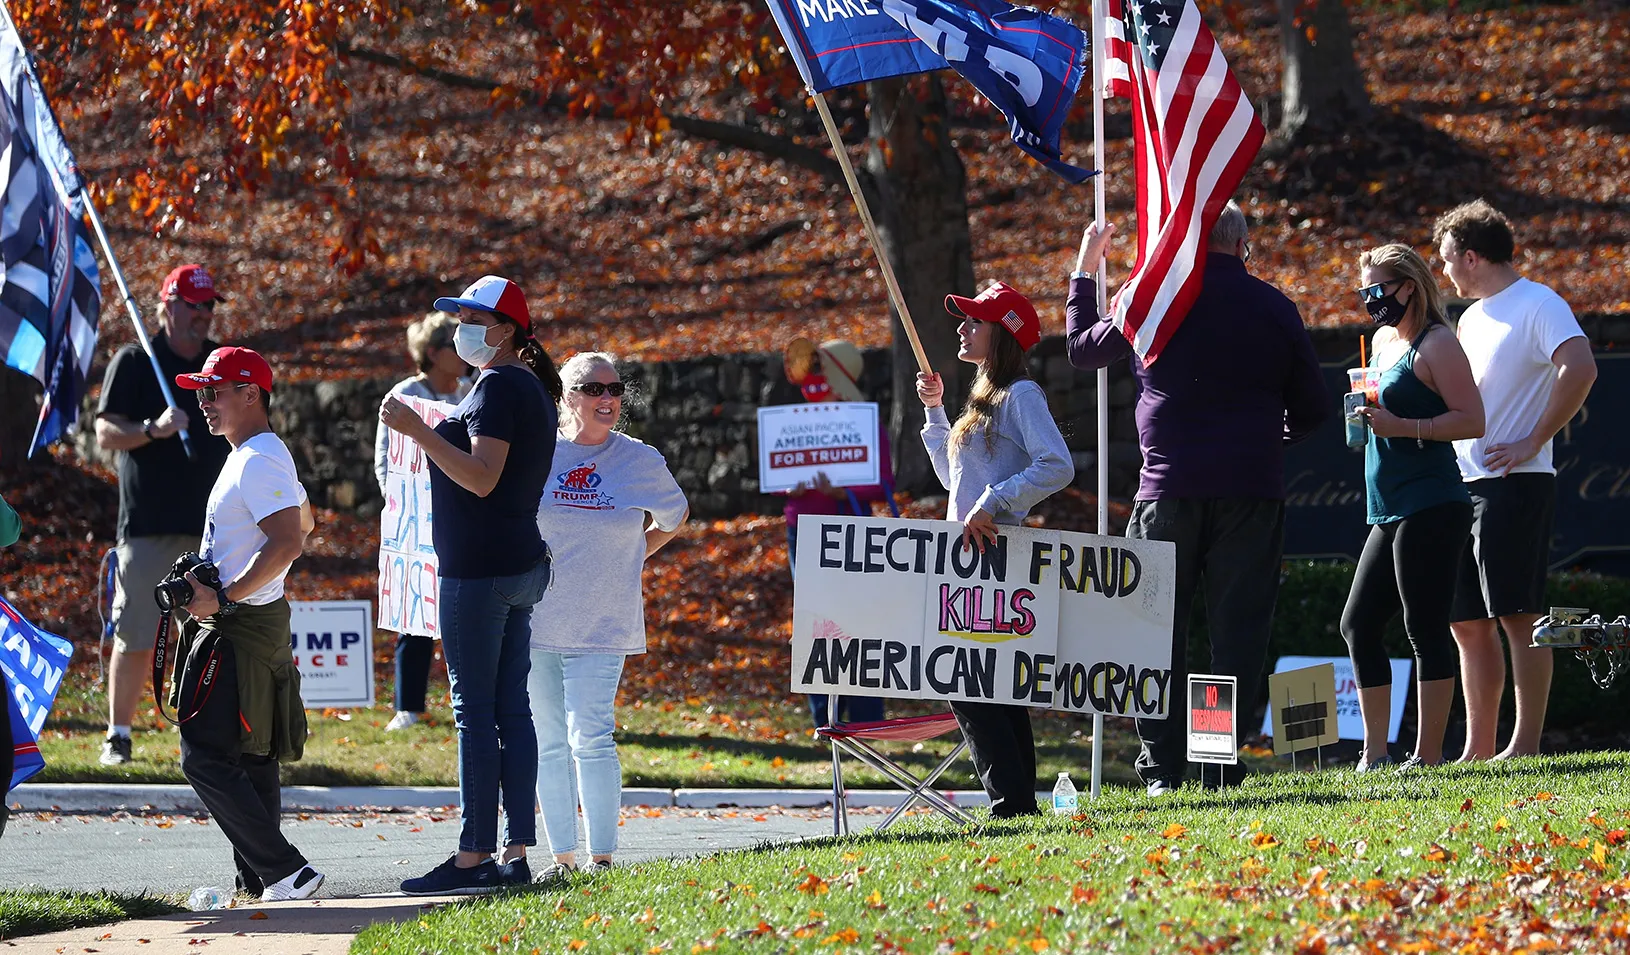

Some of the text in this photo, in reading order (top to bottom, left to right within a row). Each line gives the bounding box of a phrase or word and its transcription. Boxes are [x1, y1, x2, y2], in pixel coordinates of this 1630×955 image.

[797, 0, 879, 27] MAKE
[780, 420, 856, 436] ASIAN PACIFIC
[774, 433, 862, 449] AMERICANS
[774, 448, 864, 466] FOR TRUMP
[552, 491, 598, 501] TRUMP
[819, 523, 1142, 598] ELECTION FRAUD
[938, 583, 1036, 635] KILLS
[155, 648, 165, 669] EOS
[203, 659, 218, 685] Canon
[801, 637, 1172, 716] AMERICAN DEMOCRACY
[1205, 685, 1219, 708] NO
[1192, 709, 1232, 733] TRESPASSING
